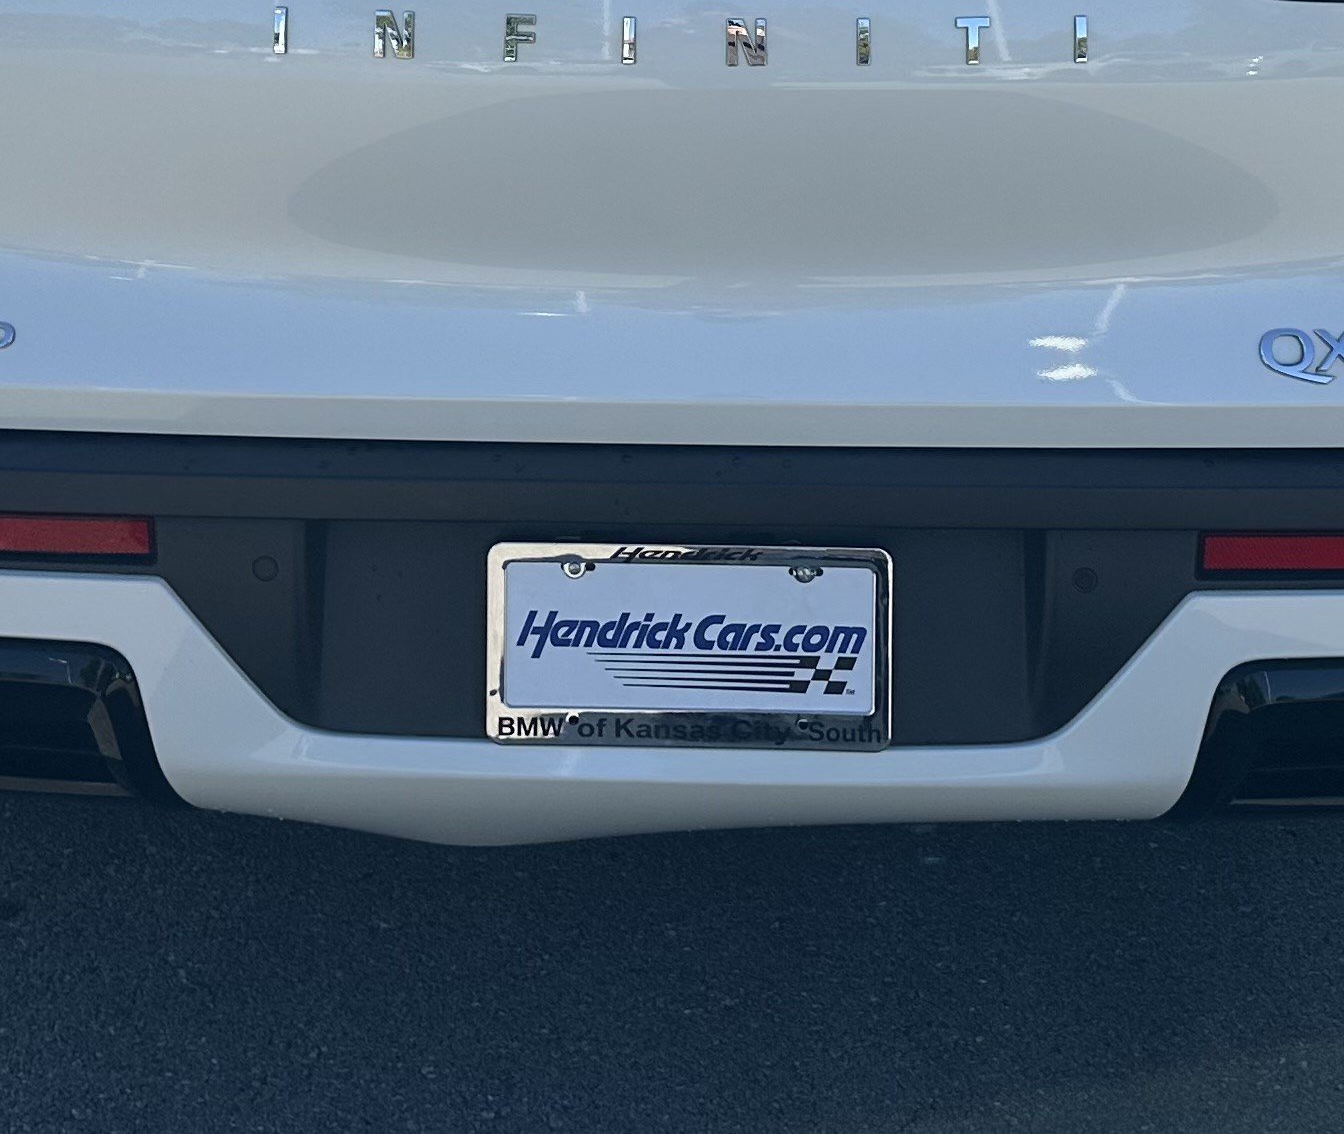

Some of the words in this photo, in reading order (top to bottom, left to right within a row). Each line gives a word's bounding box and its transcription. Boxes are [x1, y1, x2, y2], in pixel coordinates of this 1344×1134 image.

[272, 5, 1089, 67] INFINITI
[609, 546, 766, 564] Hendrick
[498, 716, 563, 737] BMW
[578, 718, 607, 738] of
[615, 718, 722, 740] Kansas
[735, 720, 791, 745] City
[807, 721, 881, 744] South
